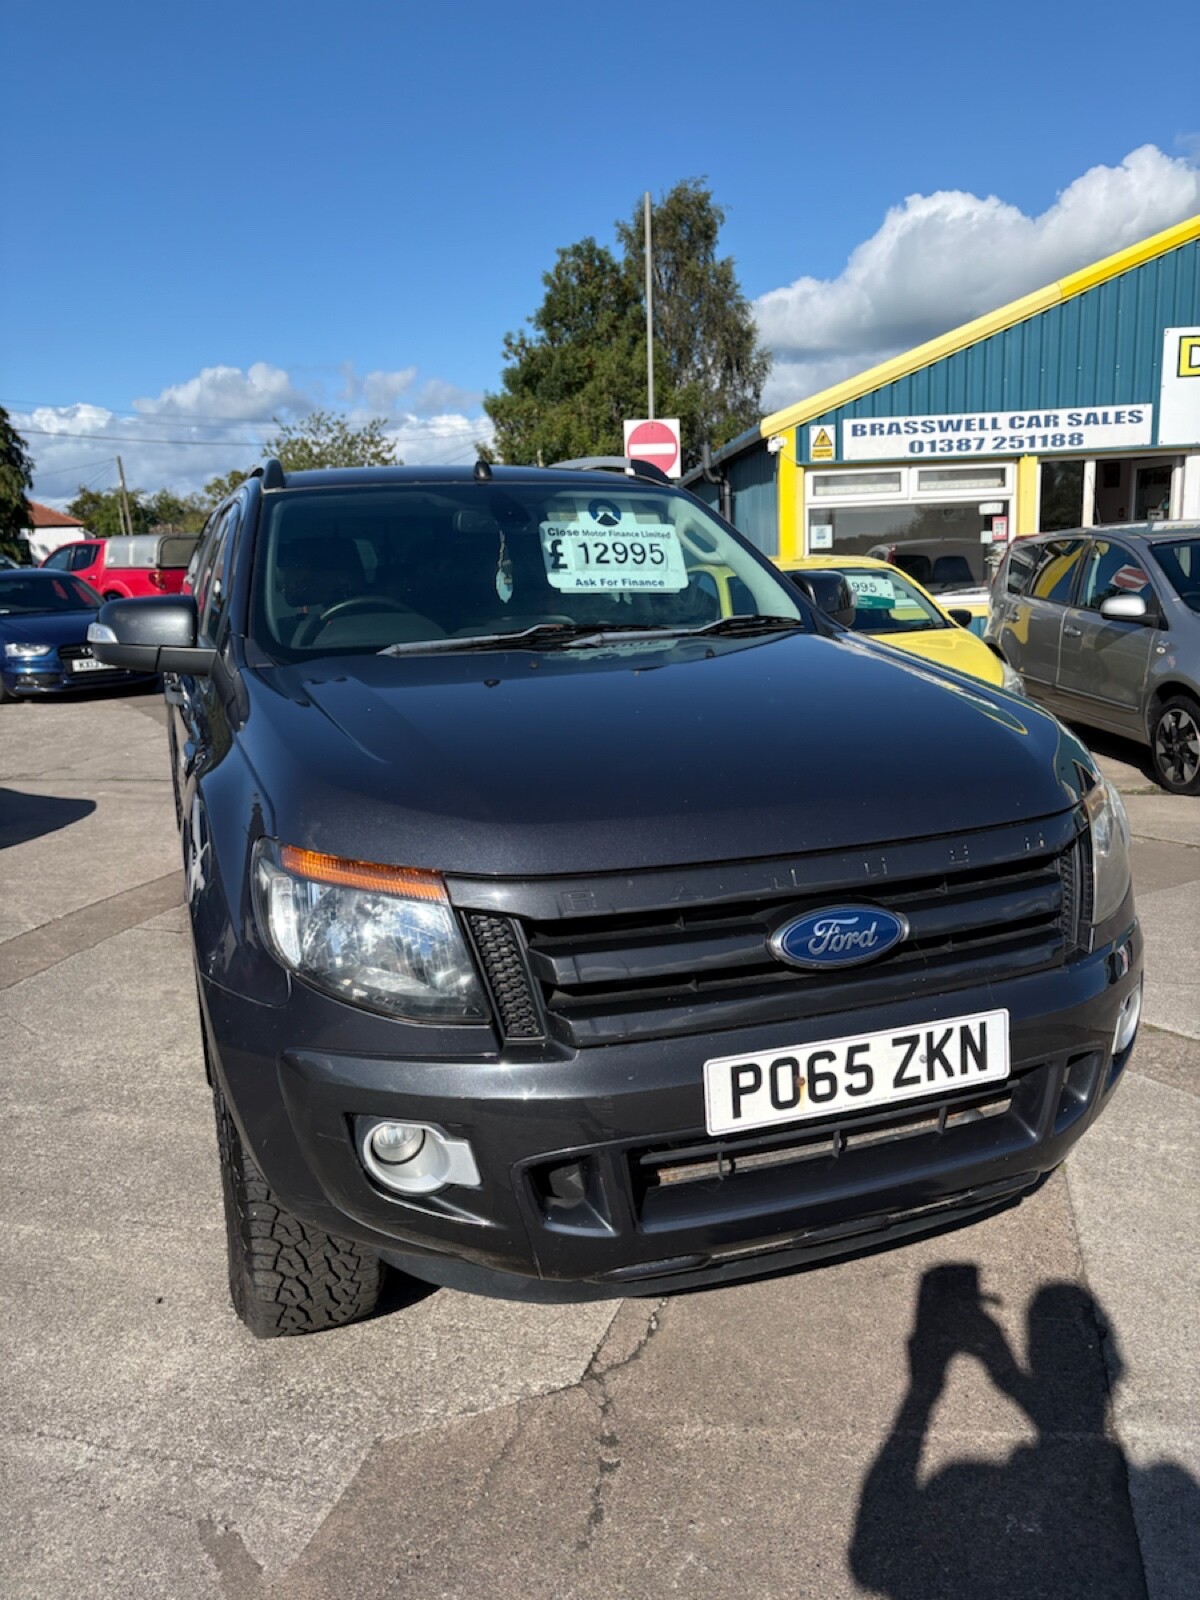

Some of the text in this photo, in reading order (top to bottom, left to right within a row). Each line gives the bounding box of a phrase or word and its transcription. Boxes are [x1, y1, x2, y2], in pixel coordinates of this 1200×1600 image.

[851, 409, 1144, 437] BRASSWELL CAR SALES
[908, 432, 1084, 454] 01387 251188
[547, 527, 671, 540] Close Motor Finance Limited
[549, 539, 665, 569] £ 12995
[575, 578, 665, 587] Ask For Finance
[808, 917, 879, 956] Ford
[730, 1021, 988, 1120] PO65 ZKN
